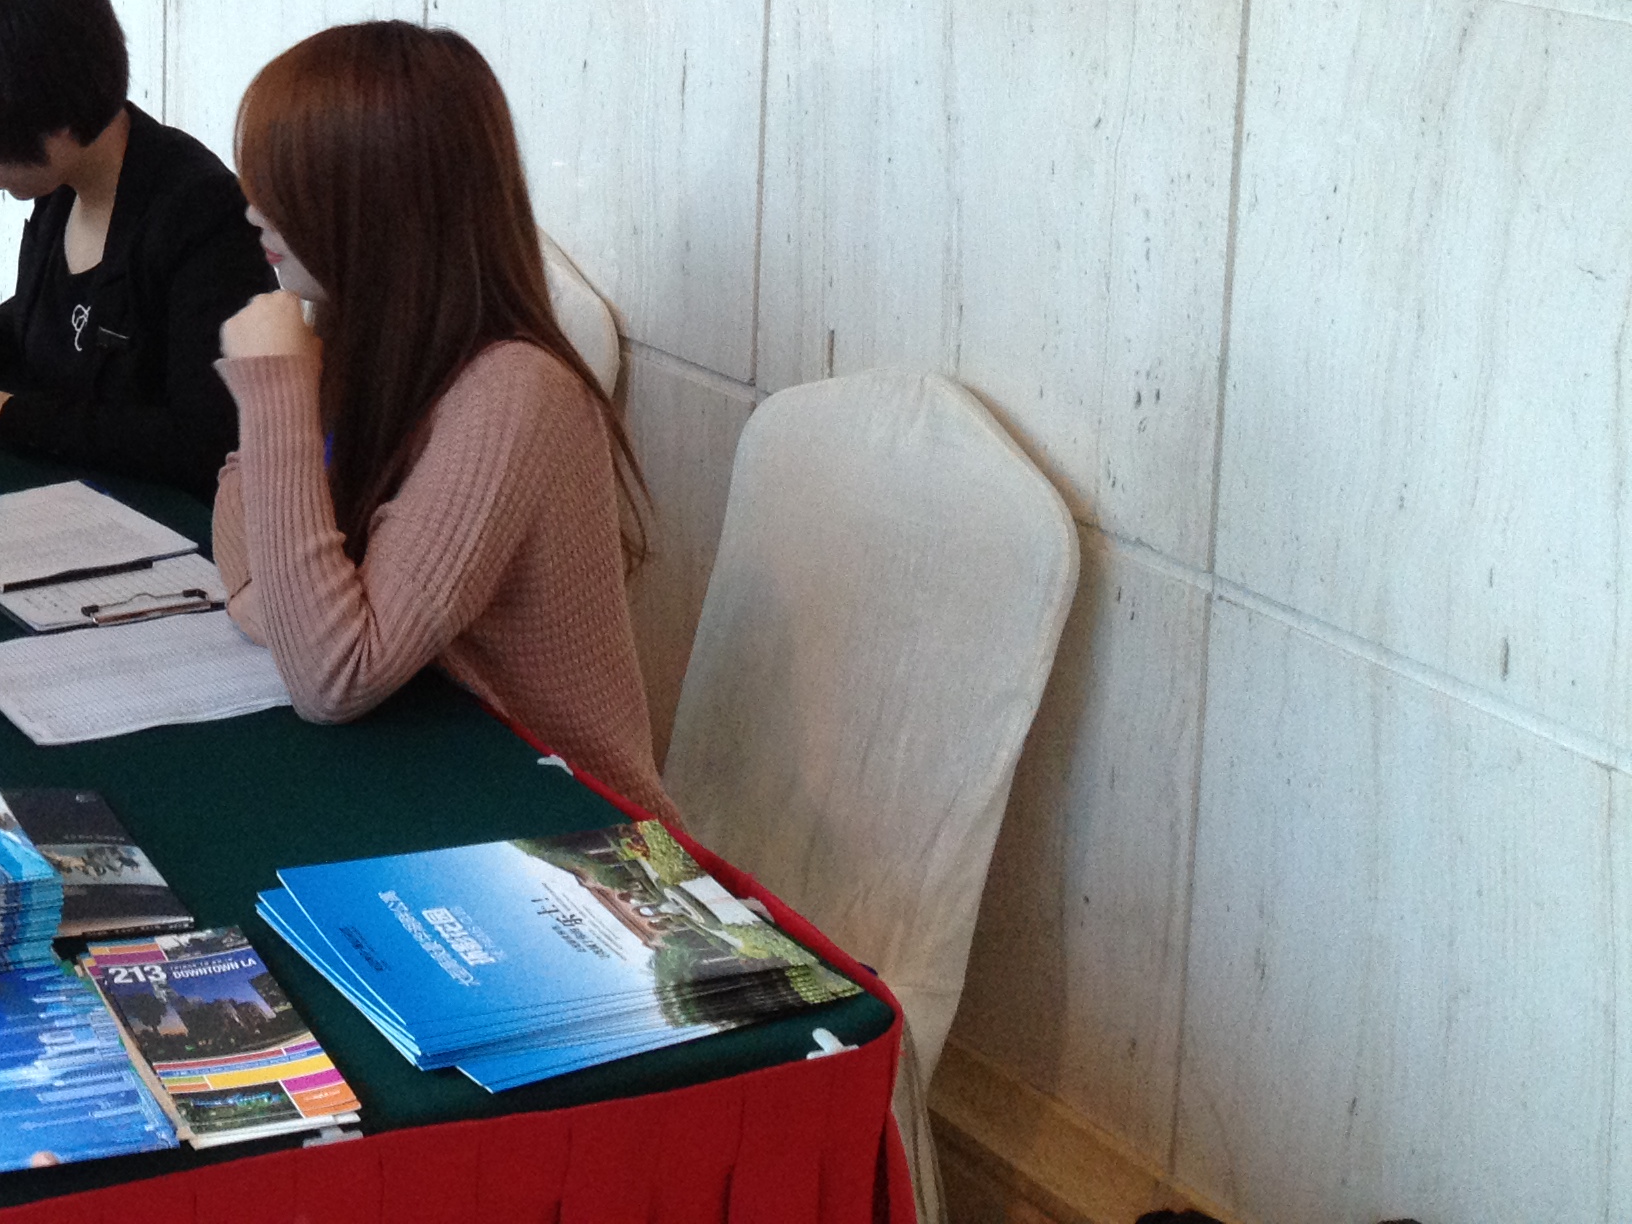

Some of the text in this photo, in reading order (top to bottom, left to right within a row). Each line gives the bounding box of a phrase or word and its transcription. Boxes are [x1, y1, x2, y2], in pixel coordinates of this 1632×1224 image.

[109, 964, 167, 984] 213
[172, 962, 239, 979] DOWNTOWN
[240, 957, 258, 968] LA
